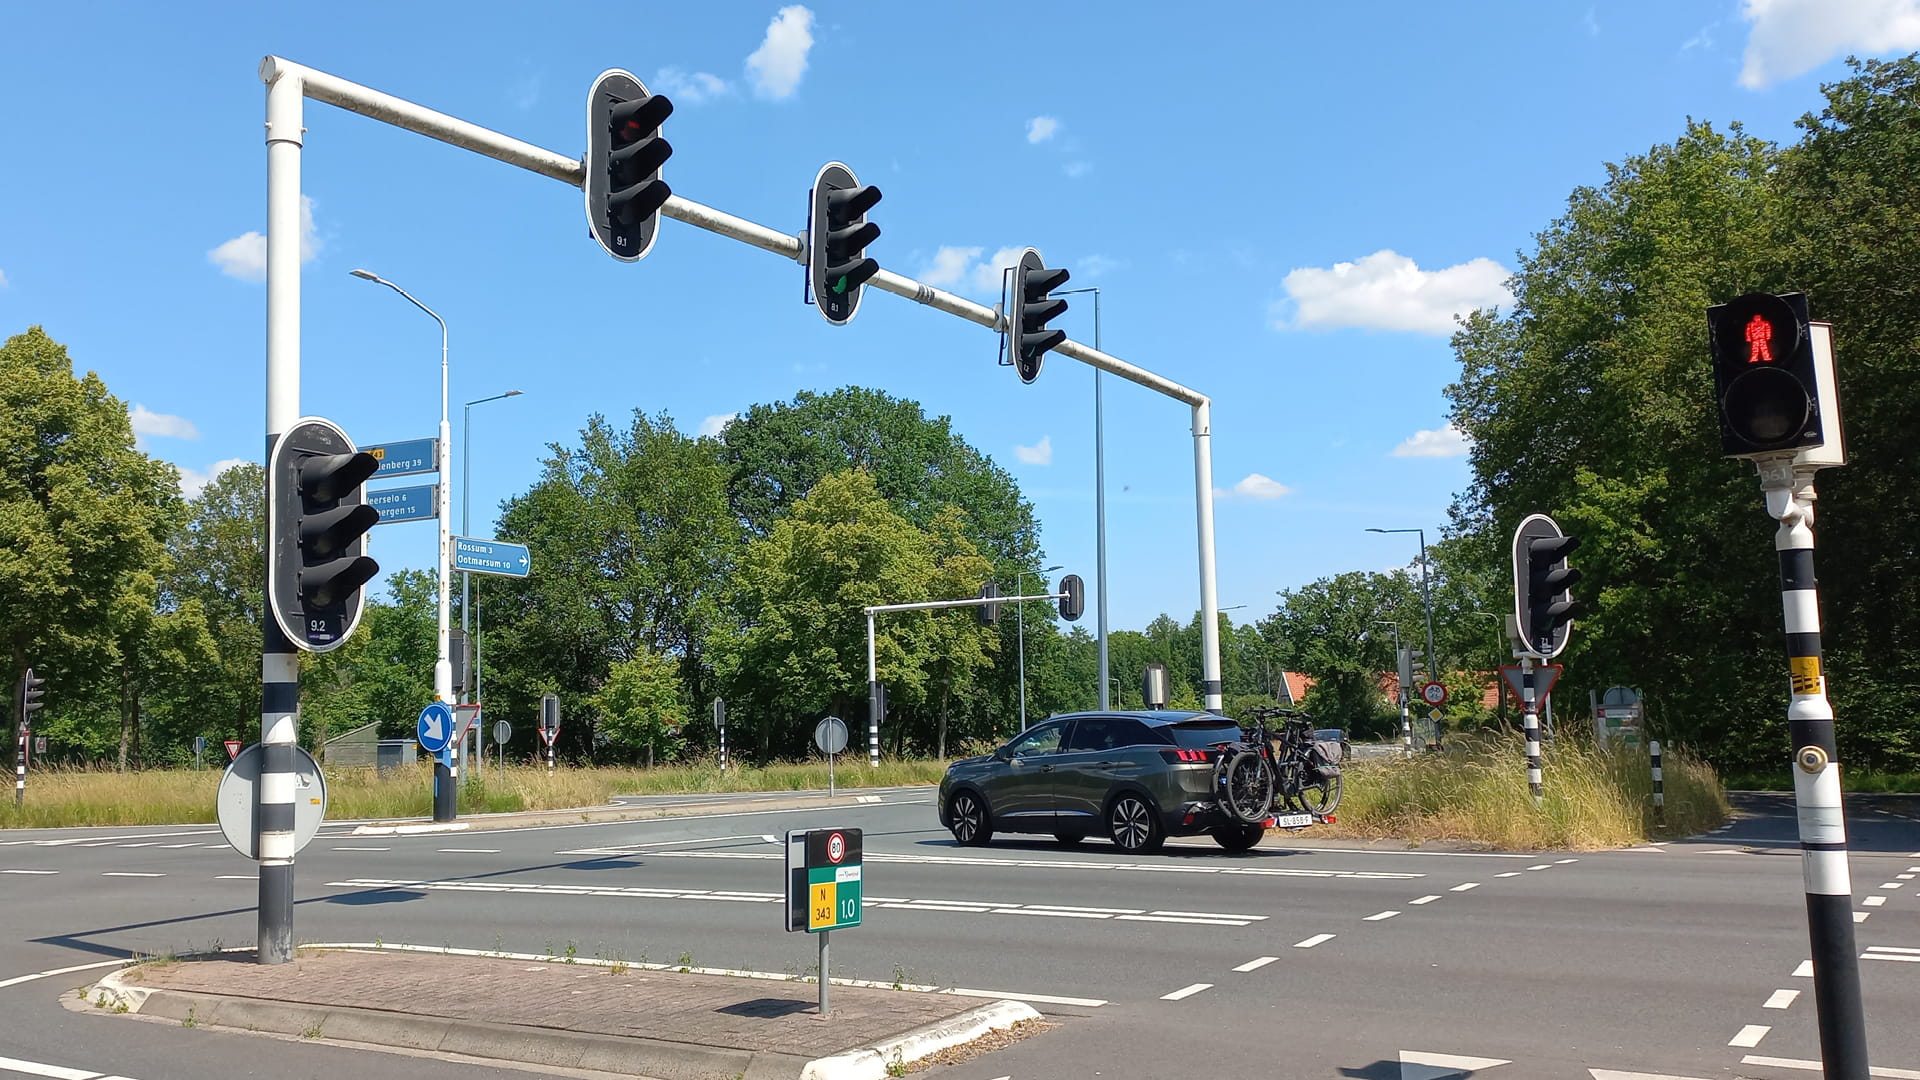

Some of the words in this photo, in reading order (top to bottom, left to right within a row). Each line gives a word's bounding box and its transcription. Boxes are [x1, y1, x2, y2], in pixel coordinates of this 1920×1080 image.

[616, 235, 627, 247] 9.1
[412, 459, 422, 467] 39
[402, 494, 407, 502] 6
[407, 506, 416, 514] 15
[457, 541, 487, 554] Rossum
[457, 554, 501, 568] Ootmarsum
[503, 561, 511, 569] 10
[310, 619, 326, 632] 9.2
[831, 842, 841, 853] 80
[820, 888, 826, 901] N
[815, 907, 831, 921] 343
